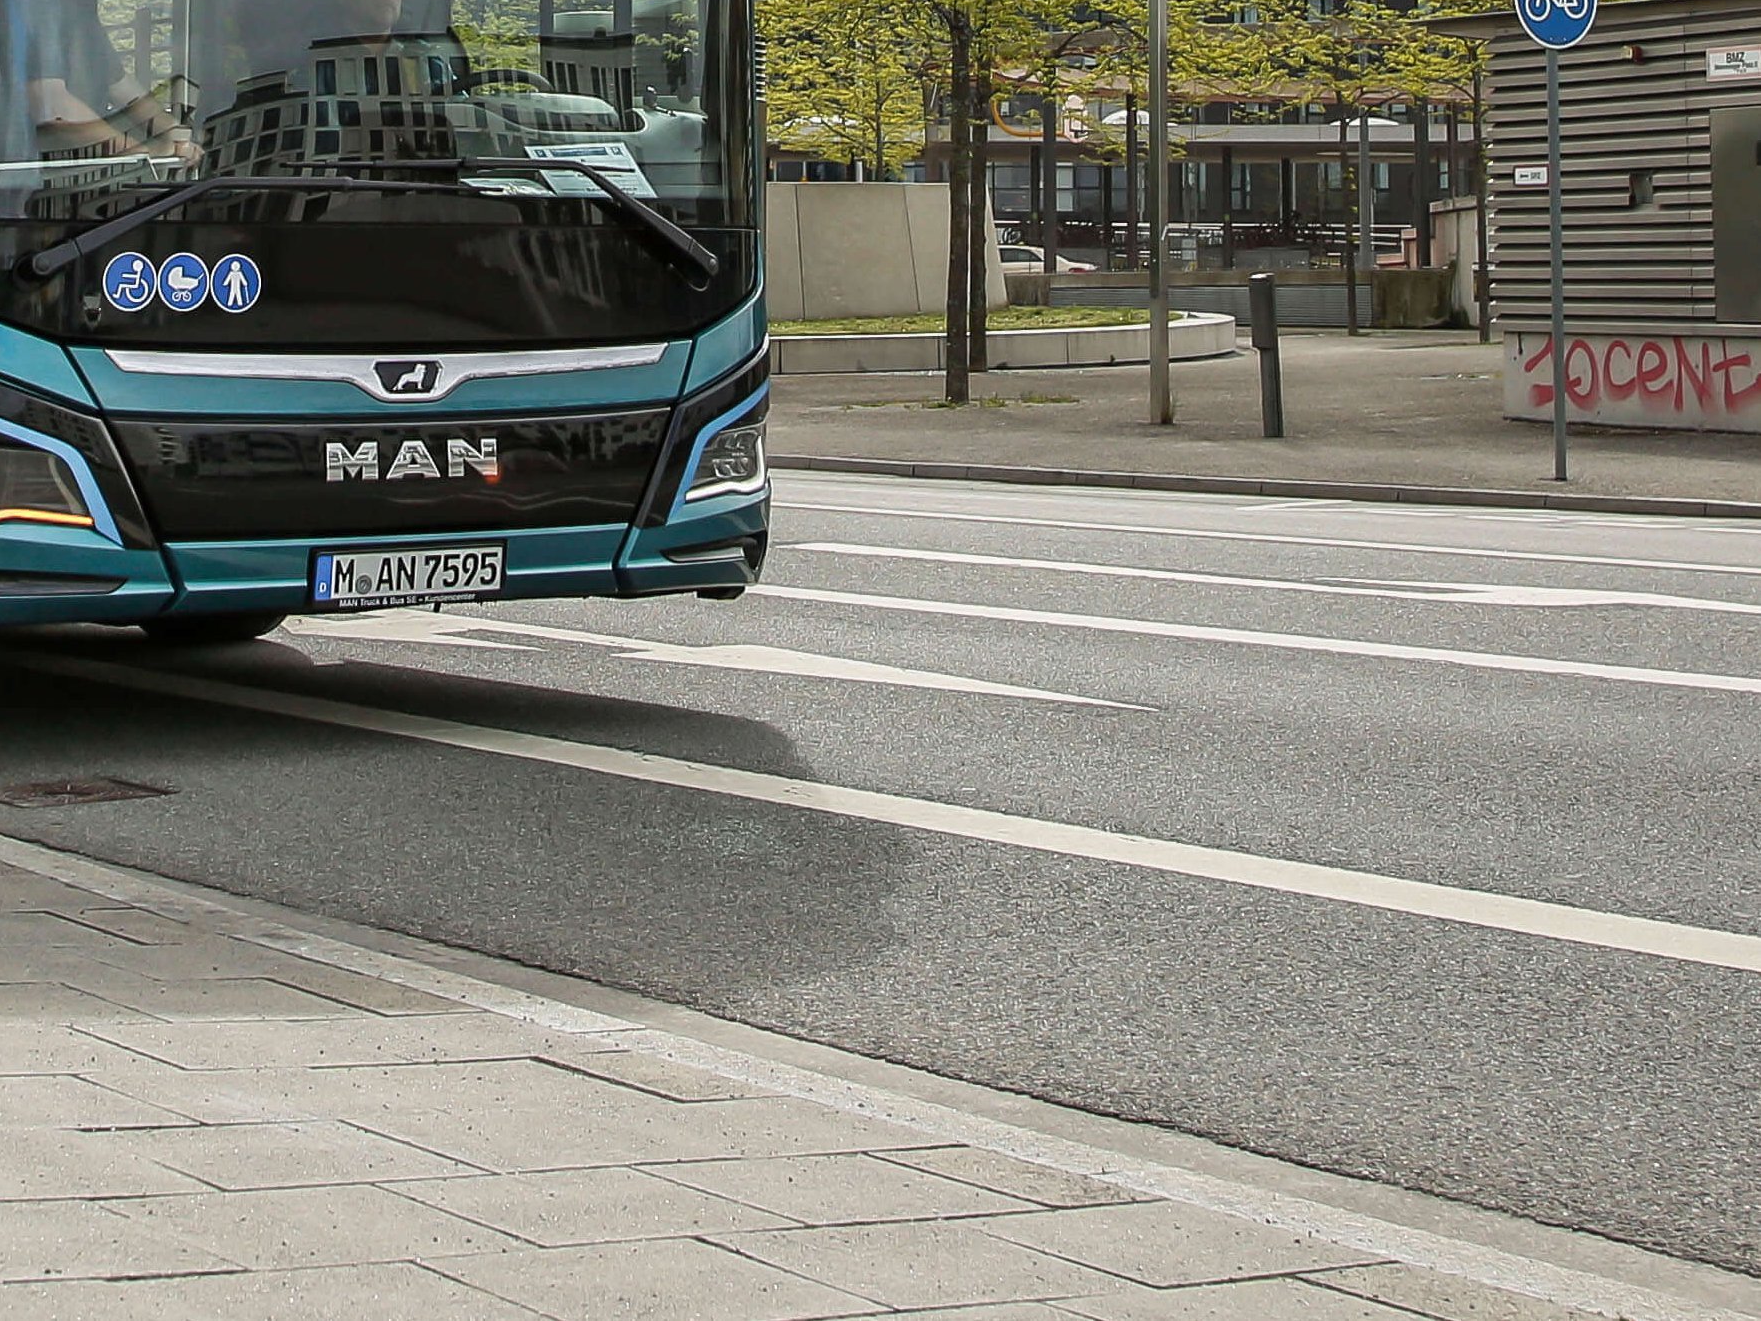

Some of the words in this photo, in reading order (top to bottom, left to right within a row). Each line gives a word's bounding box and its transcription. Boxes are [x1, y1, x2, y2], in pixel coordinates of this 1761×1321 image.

[1726, 51, 1745, 64] BMZ
[326, 438, 499, 482] MAN
[334, 558, 354, 594] M
[376, 555, 417, 592] AN
[424, 551, 499, 589] 7595
[319, 582, 327, 593] D
[339, 598, 358, 608] MAN
[360, 597, 381, 607] Truck
[390, 596, 405, 606] Bus
